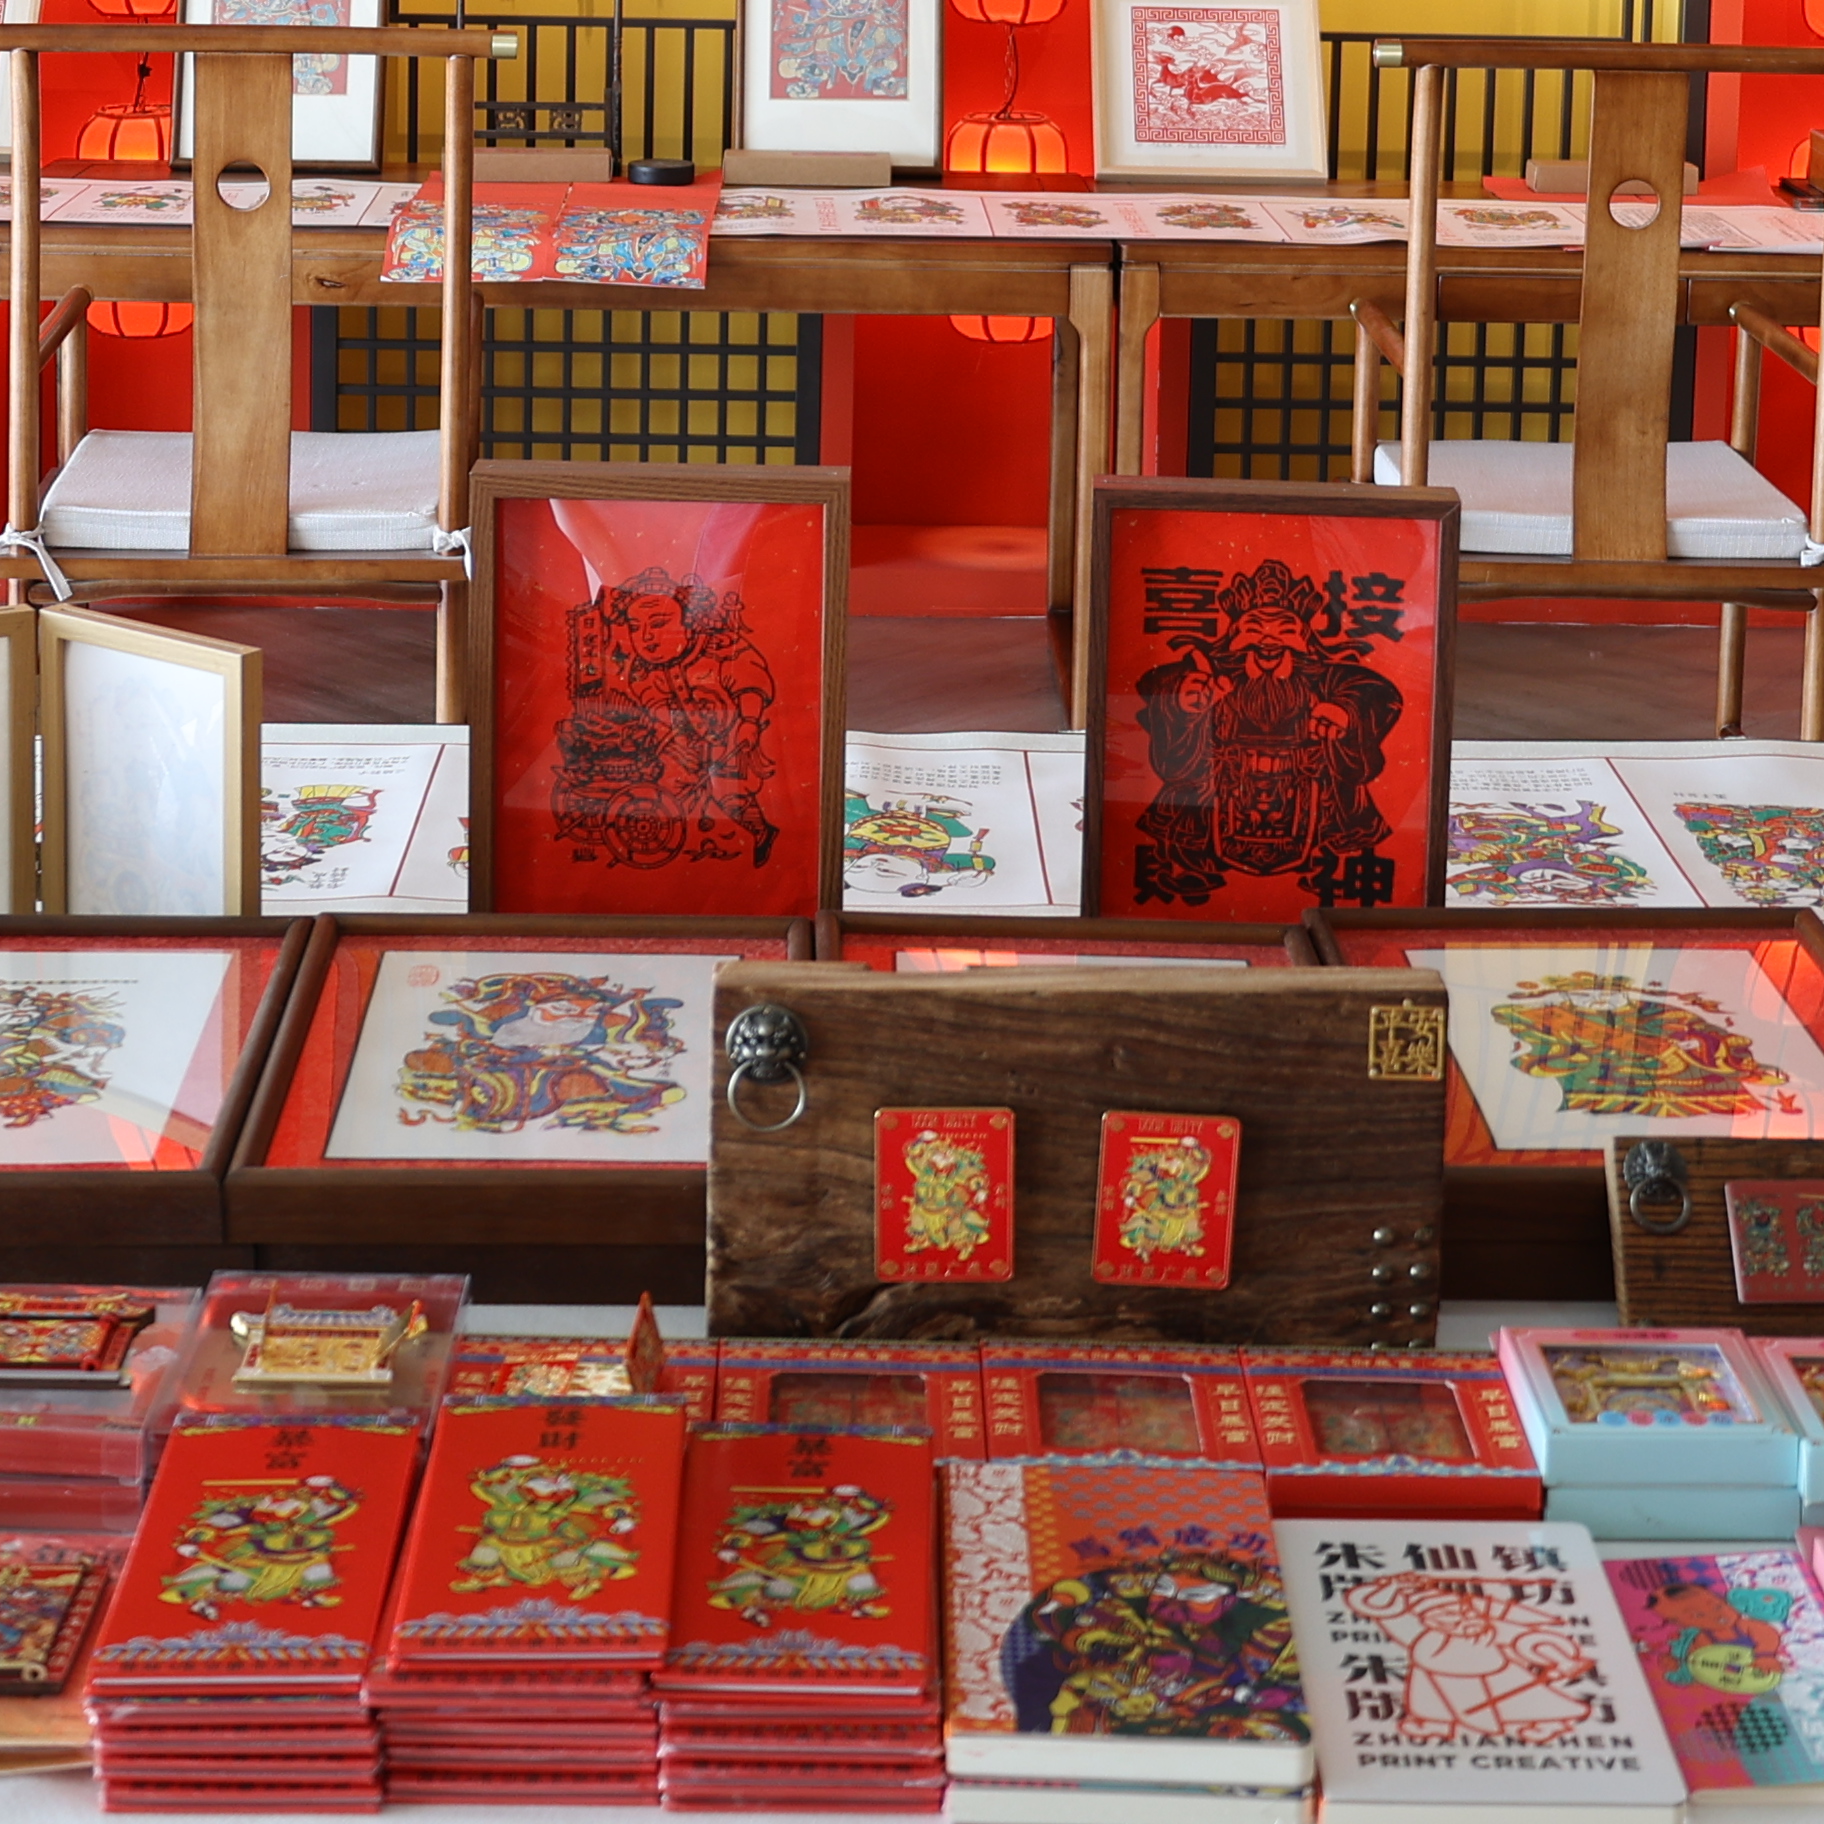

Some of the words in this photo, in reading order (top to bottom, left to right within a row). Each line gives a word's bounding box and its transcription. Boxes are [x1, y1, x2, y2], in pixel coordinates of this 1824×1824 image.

[1141, 567, 1224, 637] 喜
[1322, 570, 1405, 641] 接
[1314, 1541, 1568, 1572] 朱仙镇
[1358, 1754, 1458, 1769] PRINT
[1470, 1754, 1641, 1771] CREATIVE
